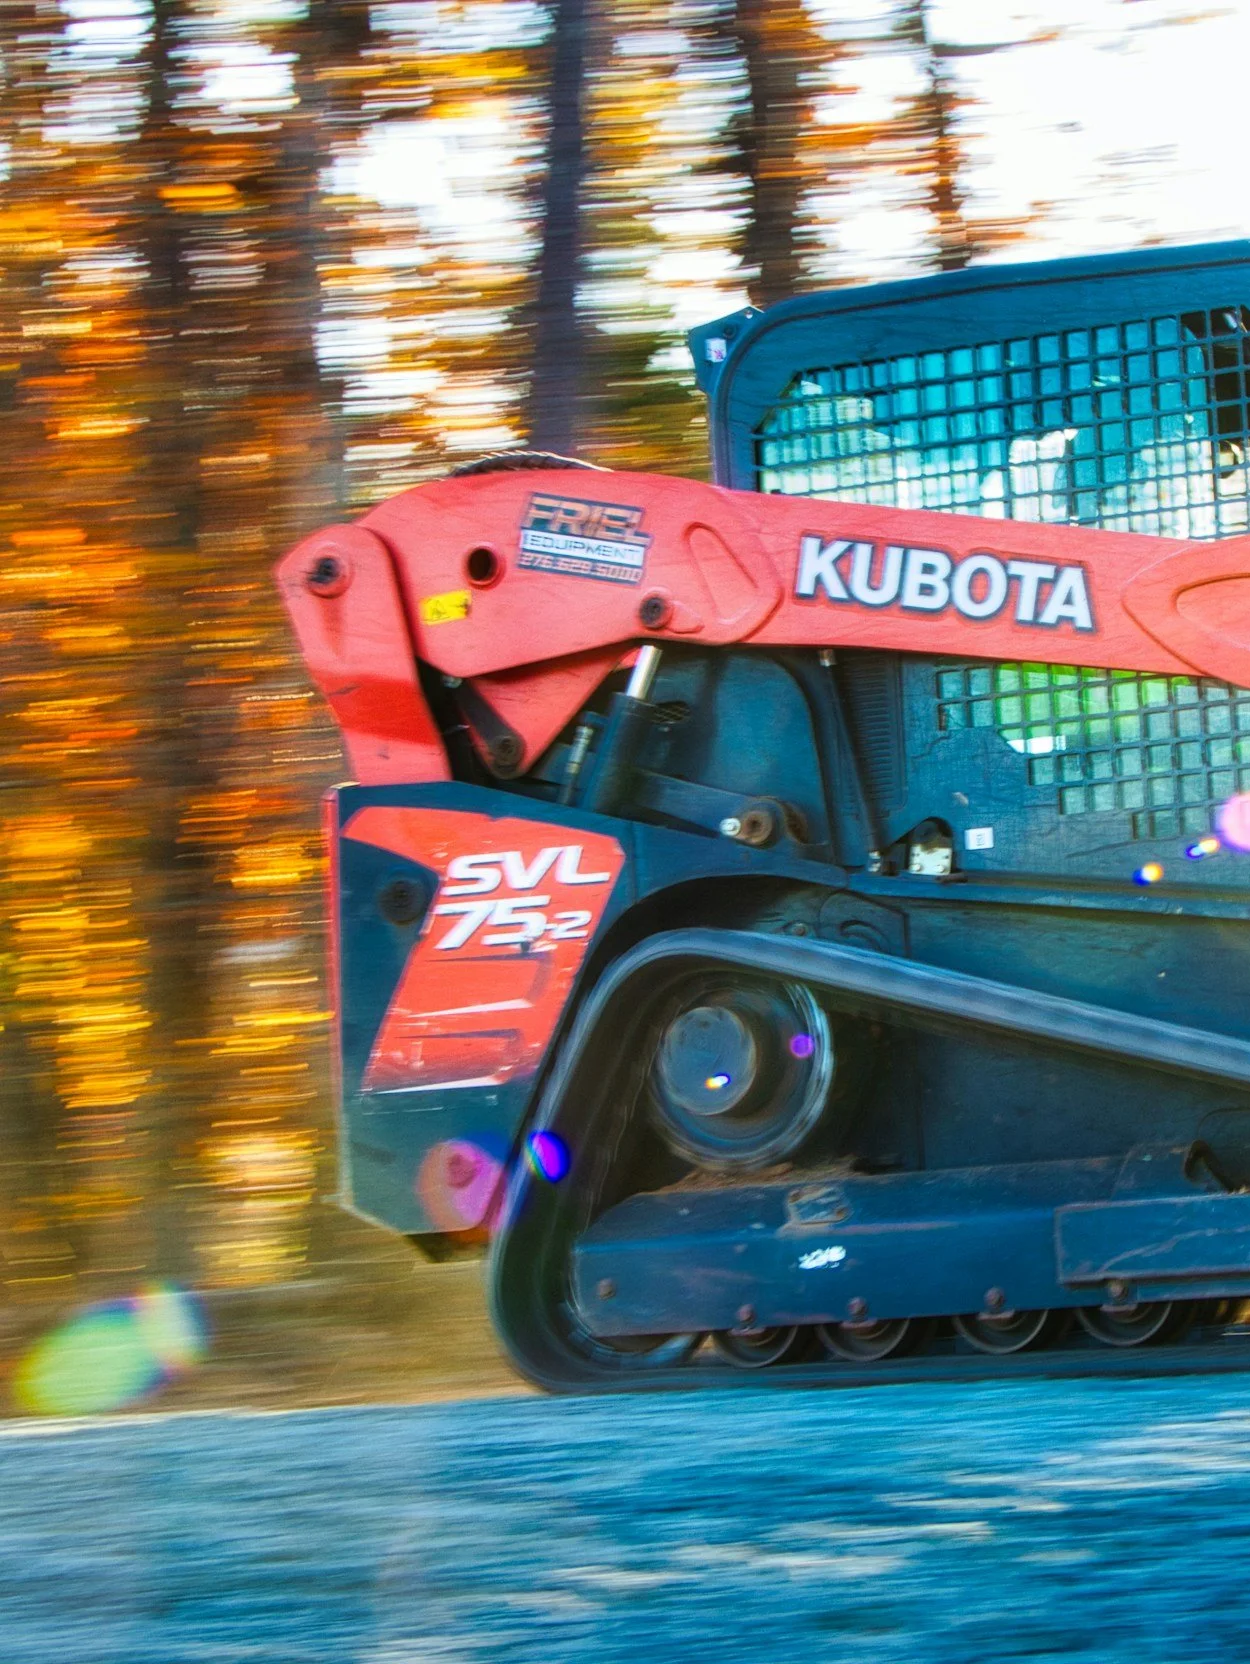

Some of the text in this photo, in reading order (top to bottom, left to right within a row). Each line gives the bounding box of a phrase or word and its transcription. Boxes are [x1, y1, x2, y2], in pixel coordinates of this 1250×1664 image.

[528, 533, 641, 562] EQUIPMENT
[795, 536, 1094, 629] KUBOTA
[440, 845, 610, 896] SVL
[433, 895, 592, 950] 75-2
